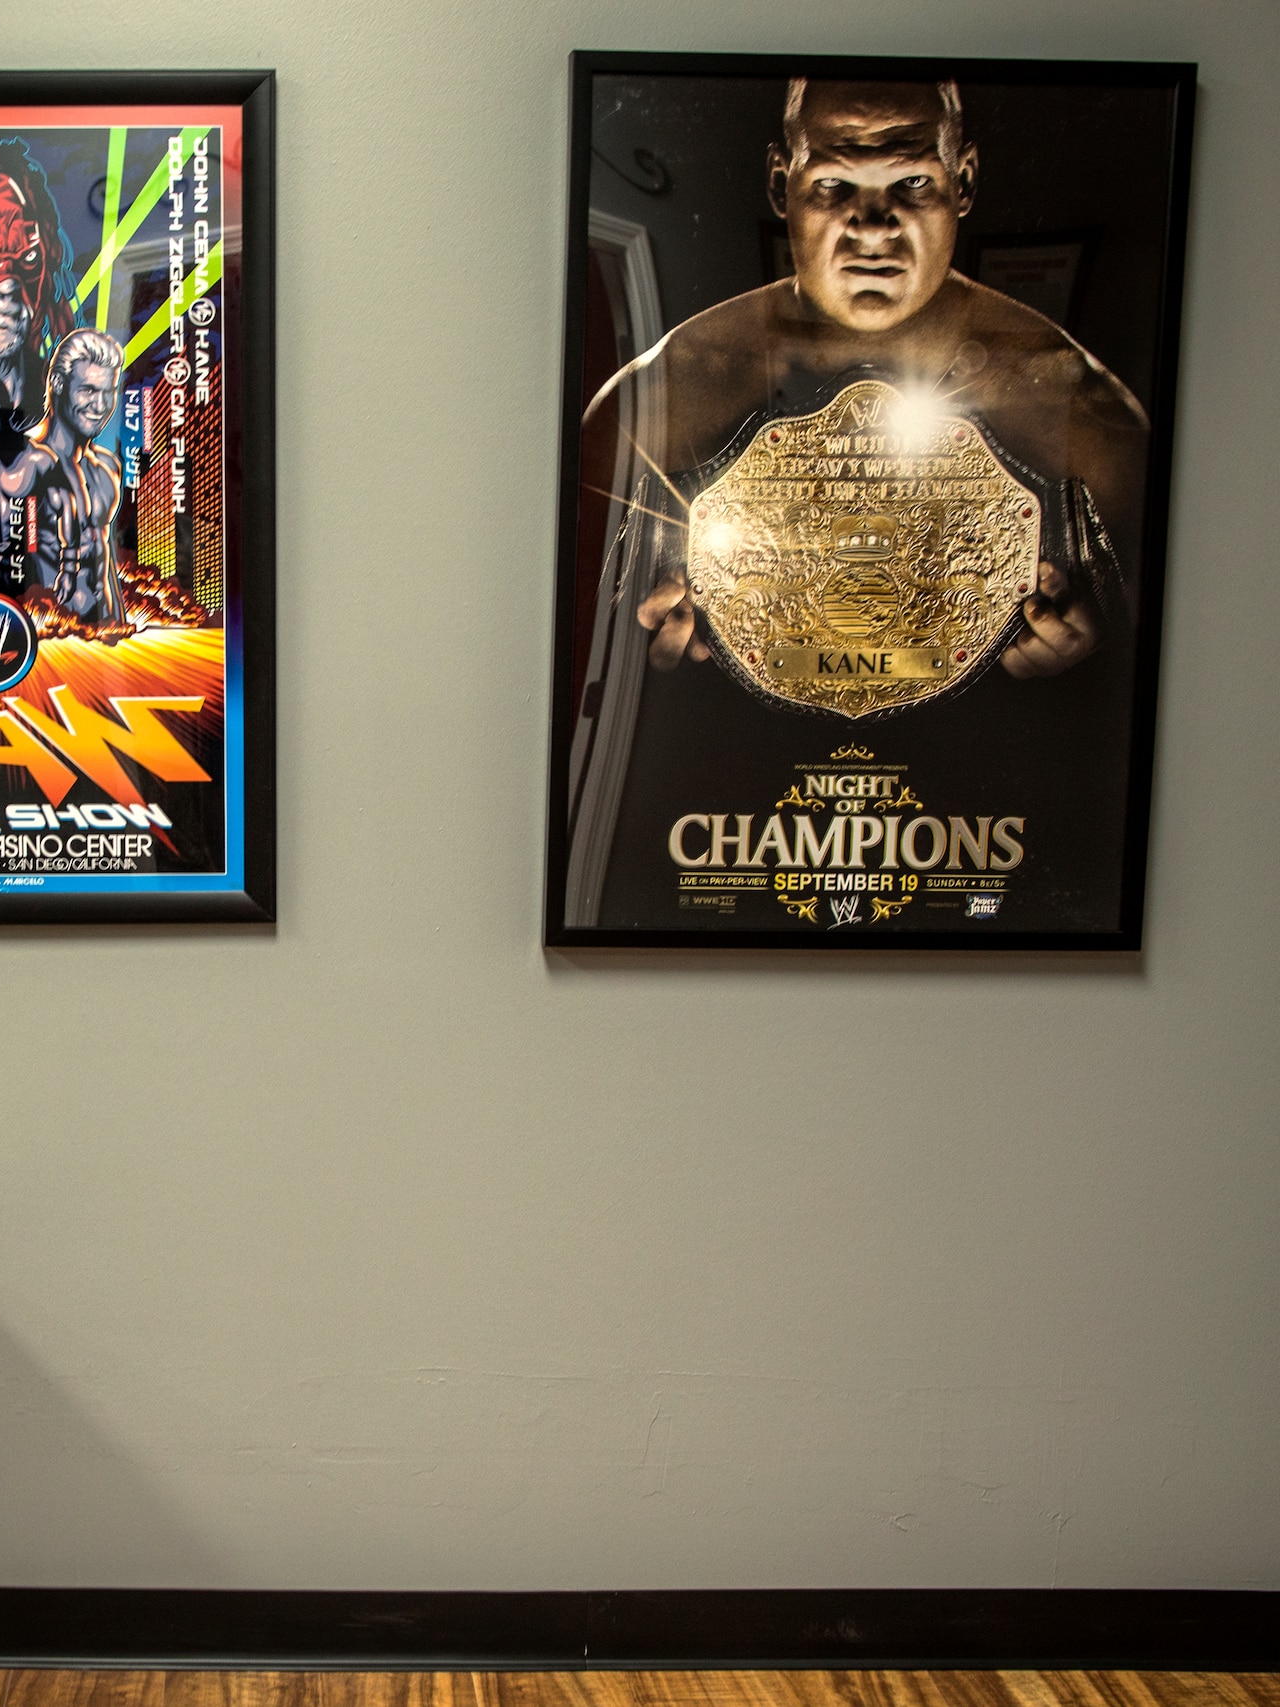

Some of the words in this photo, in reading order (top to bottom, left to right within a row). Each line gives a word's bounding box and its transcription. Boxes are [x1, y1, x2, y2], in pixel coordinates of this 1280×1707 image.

[168, 136, 184, 231] DOLPH
[193, 136, 209, 214] JOHN
[194, 220, 210, 295] CENA
[169, 238, 185, 355] ZIGGLER
[194, 328, 210, 405] KANE
[170, 389, 186, 428] CM
[170, 437, 187, 514] PUNK
[818, 653, 893, 674] KANE
[803, 774, 900, 798] NIGHT
[5, 803, 173, 831] SHOW
[834, 799, 866, 814] OF
[66, 834, 153, 857] CENTER
[668, 812, 1027, 871] CHAMPIONS
[8, 858, 33, 871] SAN
[679, 877, 697, 886] LIVE
[709, 877, 769, 886] PAY-PER-VIEW
[774, 873, 893, 892] SEPTEMBER
[898, 874, 919, 892] 19
[926, 878, 968, 888] SUNDAY
